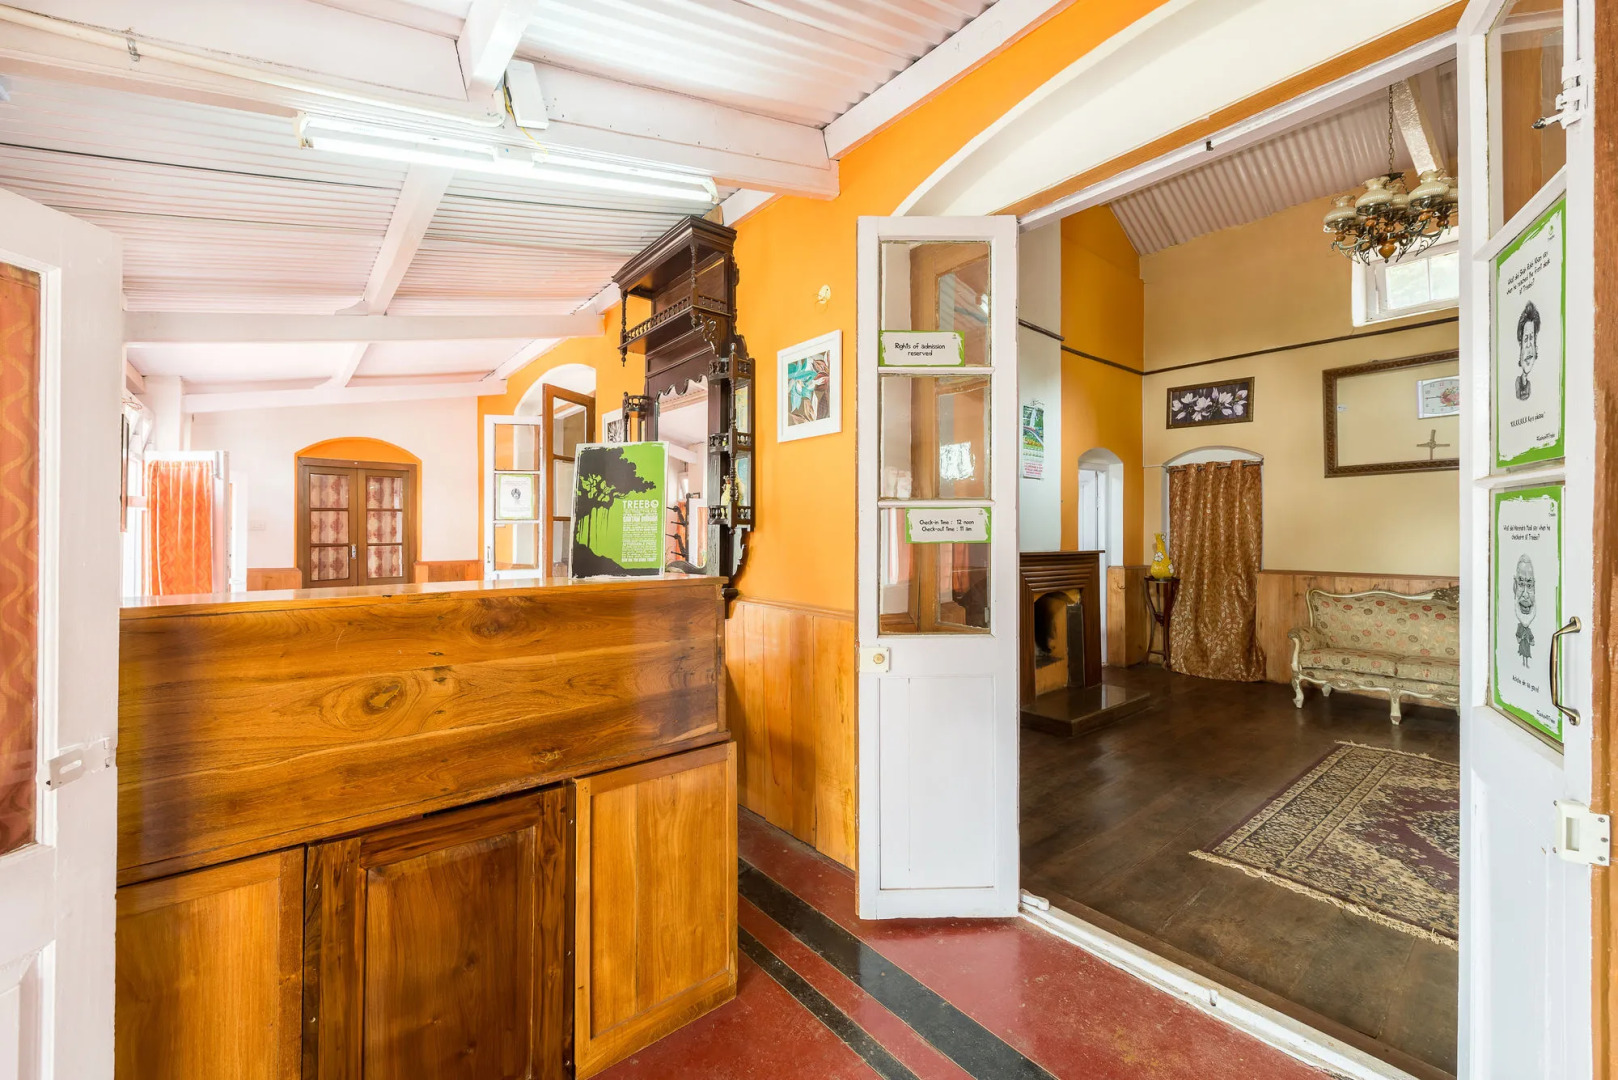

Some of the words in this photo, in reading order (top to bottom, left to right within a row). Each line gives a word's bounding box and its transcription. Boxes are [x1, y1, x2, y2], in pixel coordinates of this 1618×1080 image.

[894, 342, 911, 350] Rights
[920, 342, 946, 350] admission
[622, 499, 659, 509] TREEBO
